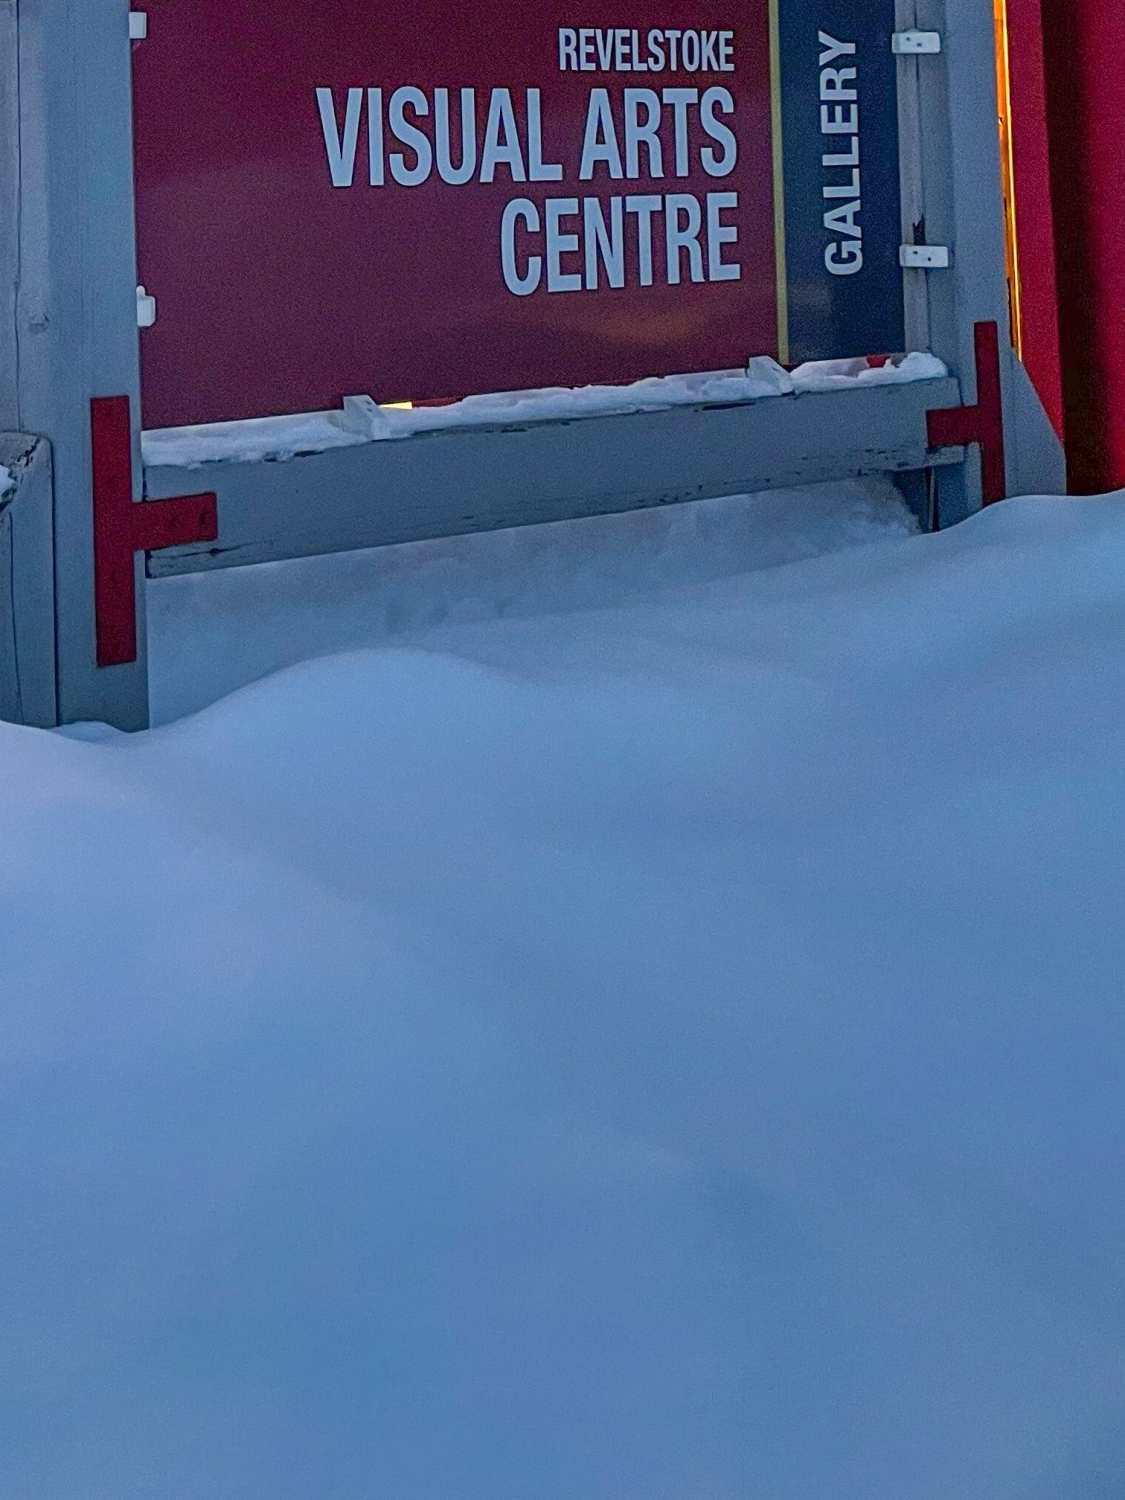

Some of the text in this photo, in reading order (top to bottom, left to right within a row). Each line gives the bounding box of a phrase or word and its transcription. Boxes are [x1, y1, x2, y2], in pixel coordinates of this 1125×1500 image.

[558, 26, 735, 73] REVELSTOKE
[316, 85, 738, 188] VISUAL ARTS
[817, 29, 863, 277] GALLERY
[501, 191, 742, 298] CENTRE
